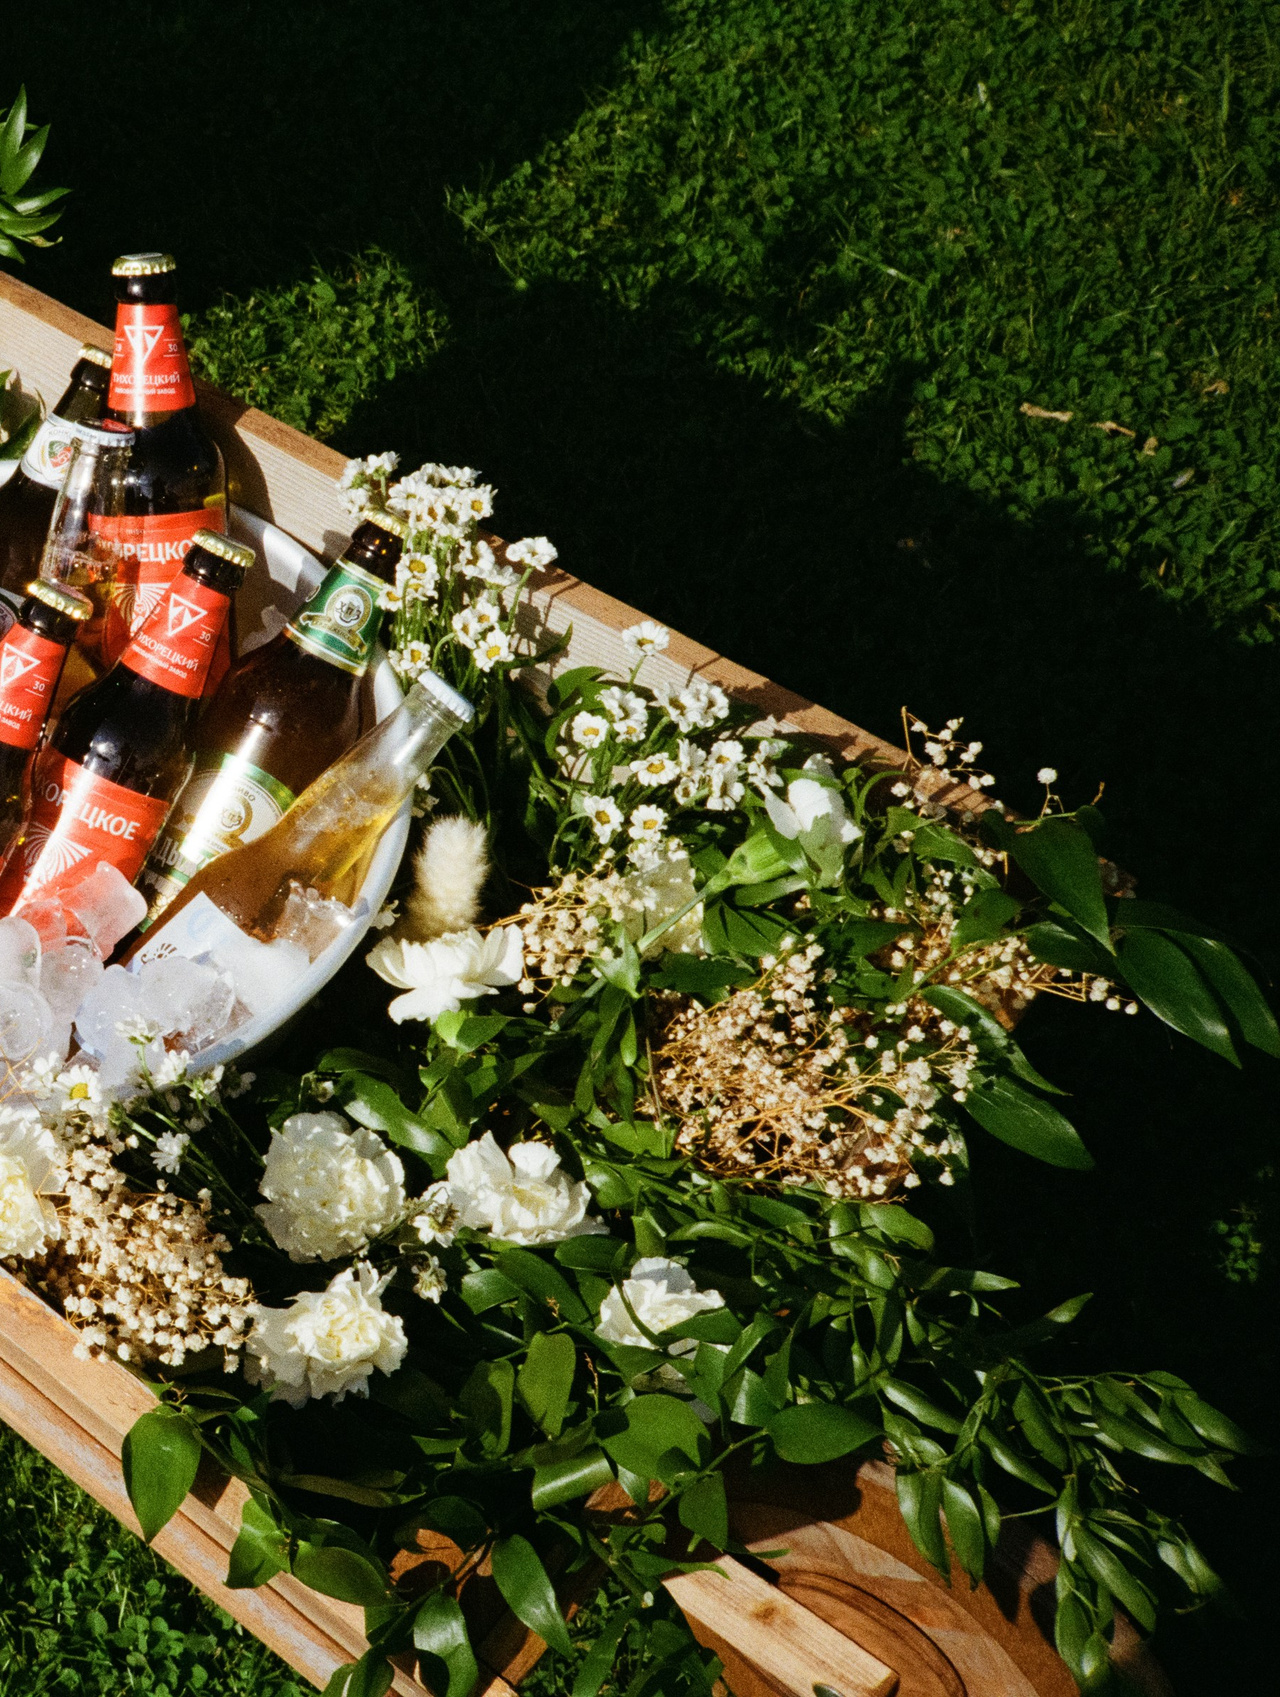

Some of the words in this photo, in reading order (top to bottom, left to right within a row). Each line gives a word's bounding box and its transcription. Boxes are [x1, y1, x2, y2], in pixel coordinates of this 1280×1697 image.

[167, 343, 178, 353] 30
[200, 631, 212, 642] 30
[32, 680, 45, 692] 30
